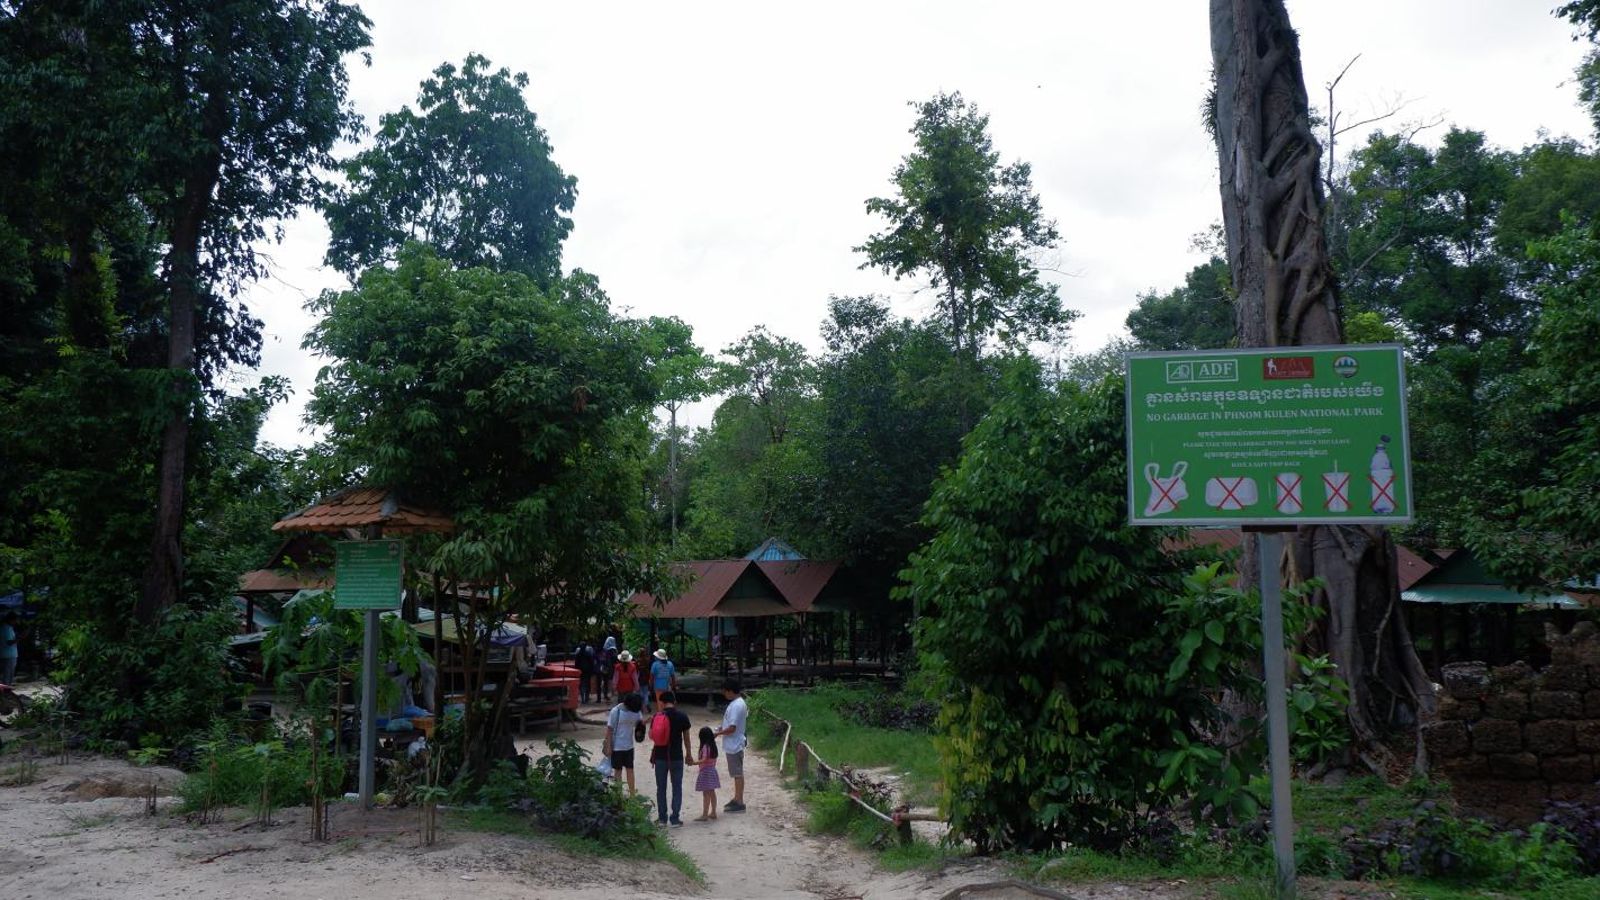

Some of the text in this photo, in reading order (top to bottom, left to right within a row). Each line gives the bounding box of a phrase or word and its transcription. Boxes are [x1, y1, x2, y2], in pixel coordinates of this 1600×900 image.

[1199, 363, 1233, 376] ADF
[1146, 407, 1384, 421] NO GARBAGE IN PHNOM KULEN NATIONAL PARK
